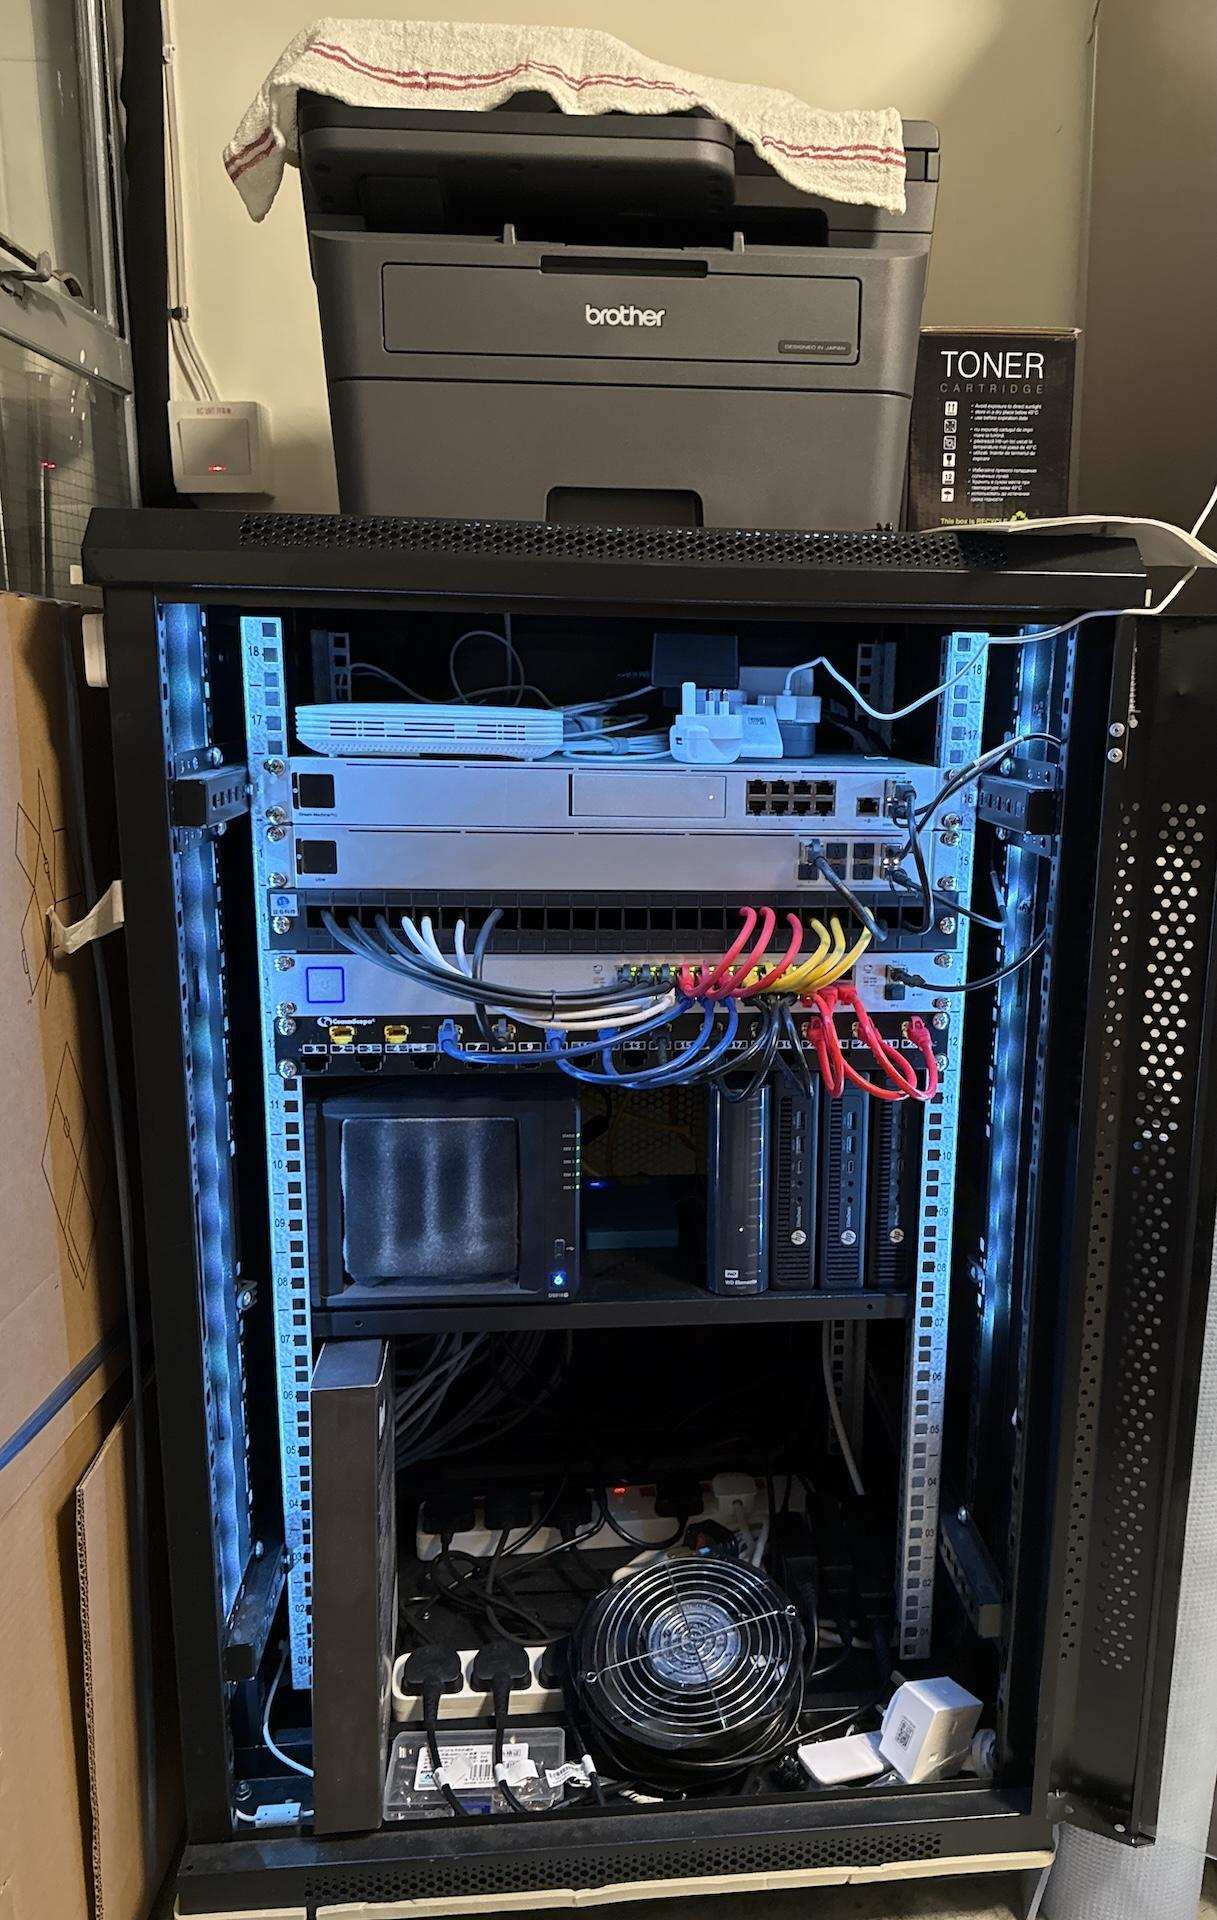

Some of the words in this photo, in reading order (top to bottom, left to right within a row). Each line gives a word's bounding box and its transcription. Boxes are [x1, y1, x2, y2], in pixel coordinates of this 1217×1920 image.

[585, 304, 666, 327] brother
[940, 350, 1045, 379] TONER
[940, 383, 1043, 394] CARTRIDGE
[248, 645, 259, 656] 18
[972, 664, 982, 675] 18
[251, 714, 263, 725] 17
[967, 729, 978, 739] 17
[270, 1099, 280, 1109] 11
[944, 1095, 953, 1104] 11
[942, 1150, 952, 1159] 10
[273, 1161, 283, 1169] 10
[938, 1207, 949, 1216] 09
[275, 1219, 285, 1228] 09
[937, 1263, 947, 1272] 08
[277, 1278, 288, 1286] 08
[934, 1318, 944, 1327] 07
[281, 1335, 290, 1344] 07
[932, 1371, 942, 1380] 06
[283, 1391, 293, 1399] 06
[930, 1425, 939, 1434] 05
[286, 1446, 296, 1454] 05
[927, 1477, 937, 1486] 04
[288, 1500, 298, 1508] 04
[925, 1528, 934, 1537] 03
